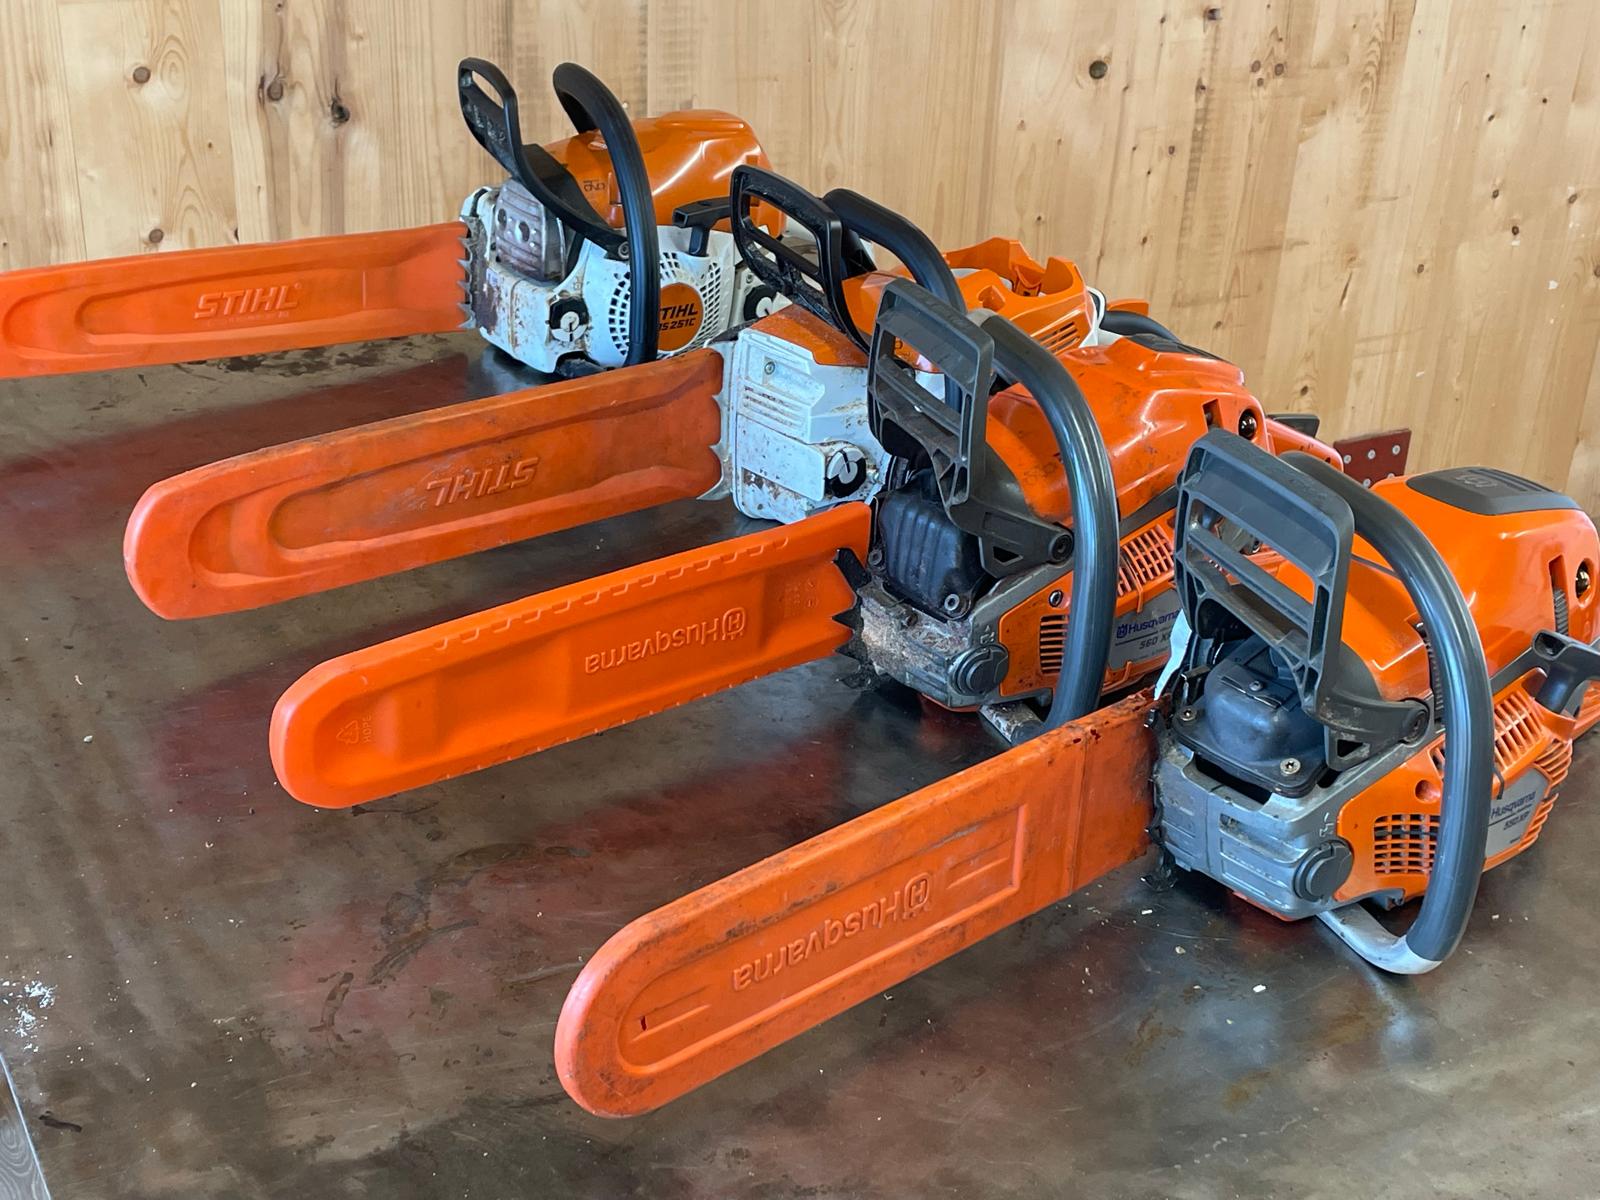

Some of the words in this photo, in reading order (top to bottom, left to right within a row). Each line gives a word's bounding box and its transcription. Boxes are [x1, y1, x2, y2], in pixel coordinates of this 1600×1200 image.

[193, 284, 299, 319] STIHL
[658, 303, 698, 320] TIHL
[426, 457, 539, 507] STIHL
[584, 616, 718, 674] Husqvarna
[1490, 791, 1537, 819] Husqvarna
[732, 890, 900, 992] Husqvarna
